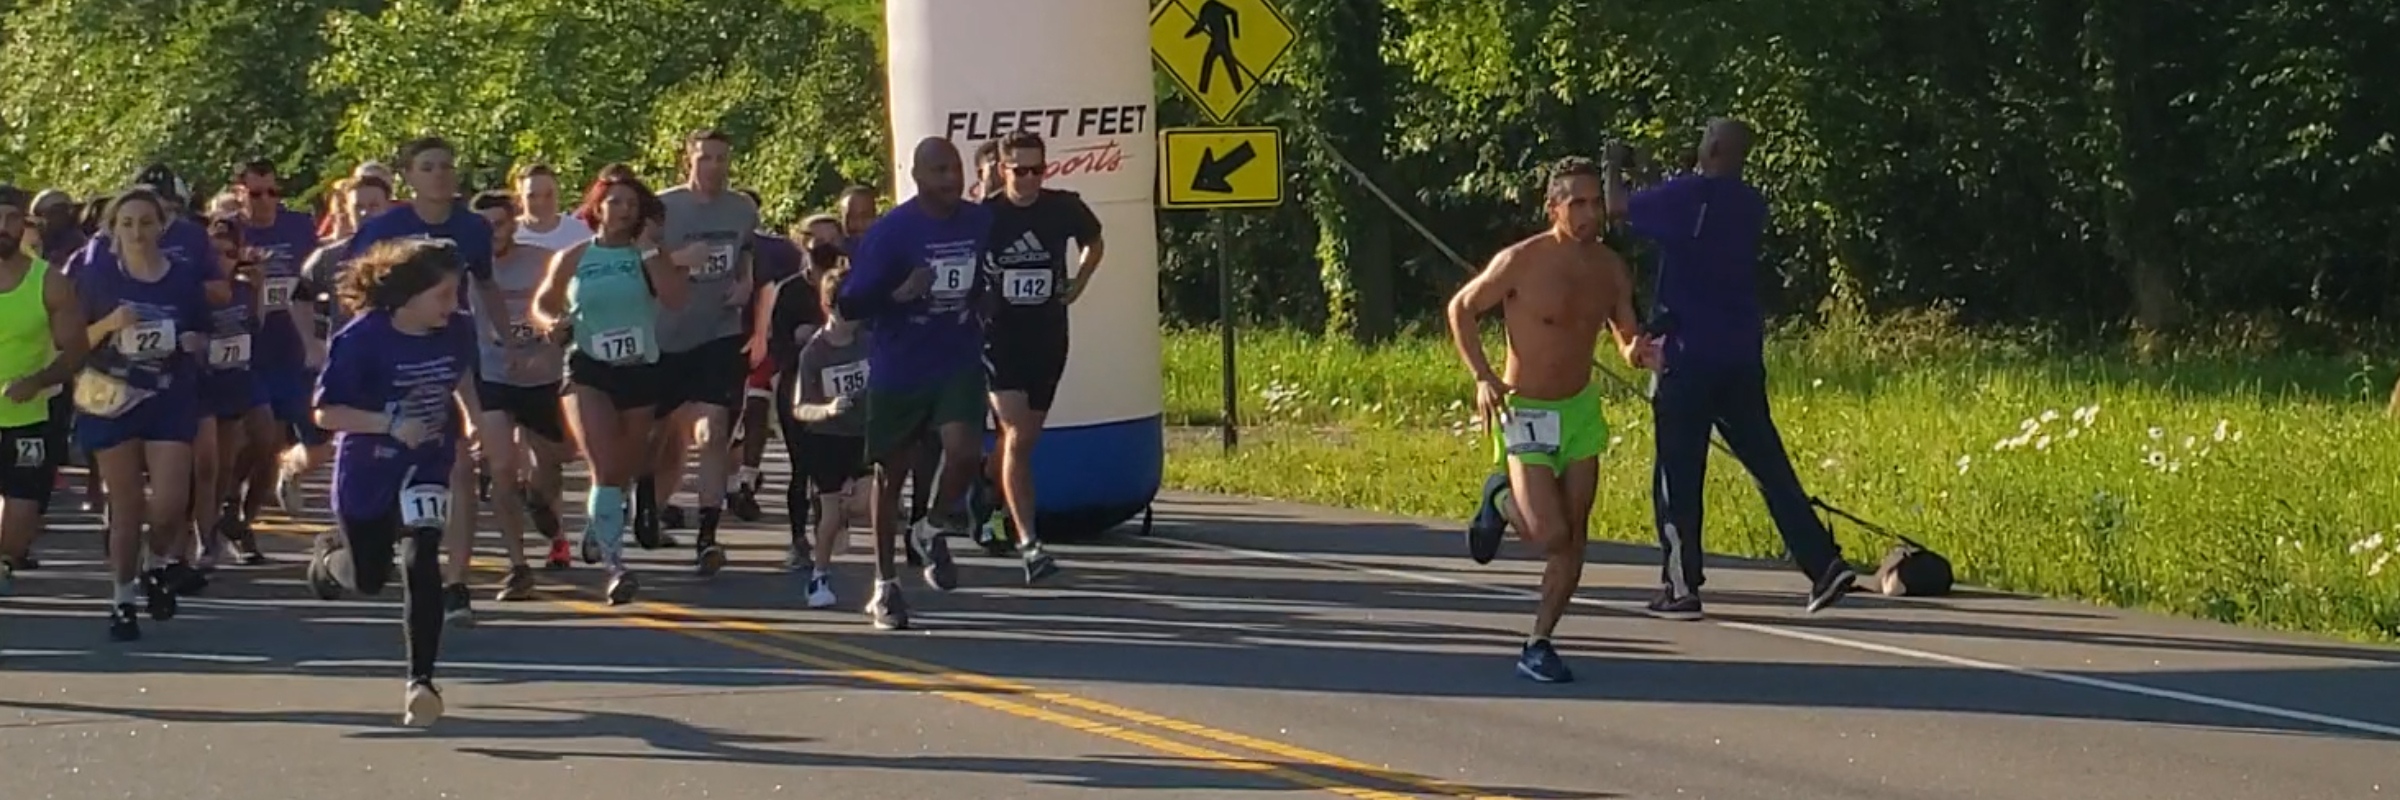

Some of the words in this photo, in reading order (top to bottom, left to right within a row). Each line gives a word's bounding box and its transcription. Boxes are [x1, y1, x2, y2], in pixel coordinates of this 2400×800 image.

[945, 109, 1069, 141] FLEET
[1077, 105, 1147, 137] FEET
[948, 268, 961, 290] 6
[1013, 279, 1046, 296] 142
[136, 331, 162, 351] 22
[601, 336, 637, 359] 179
[832, 371, 865, 395] 135
[1525, 421, 1536, 441] 1
